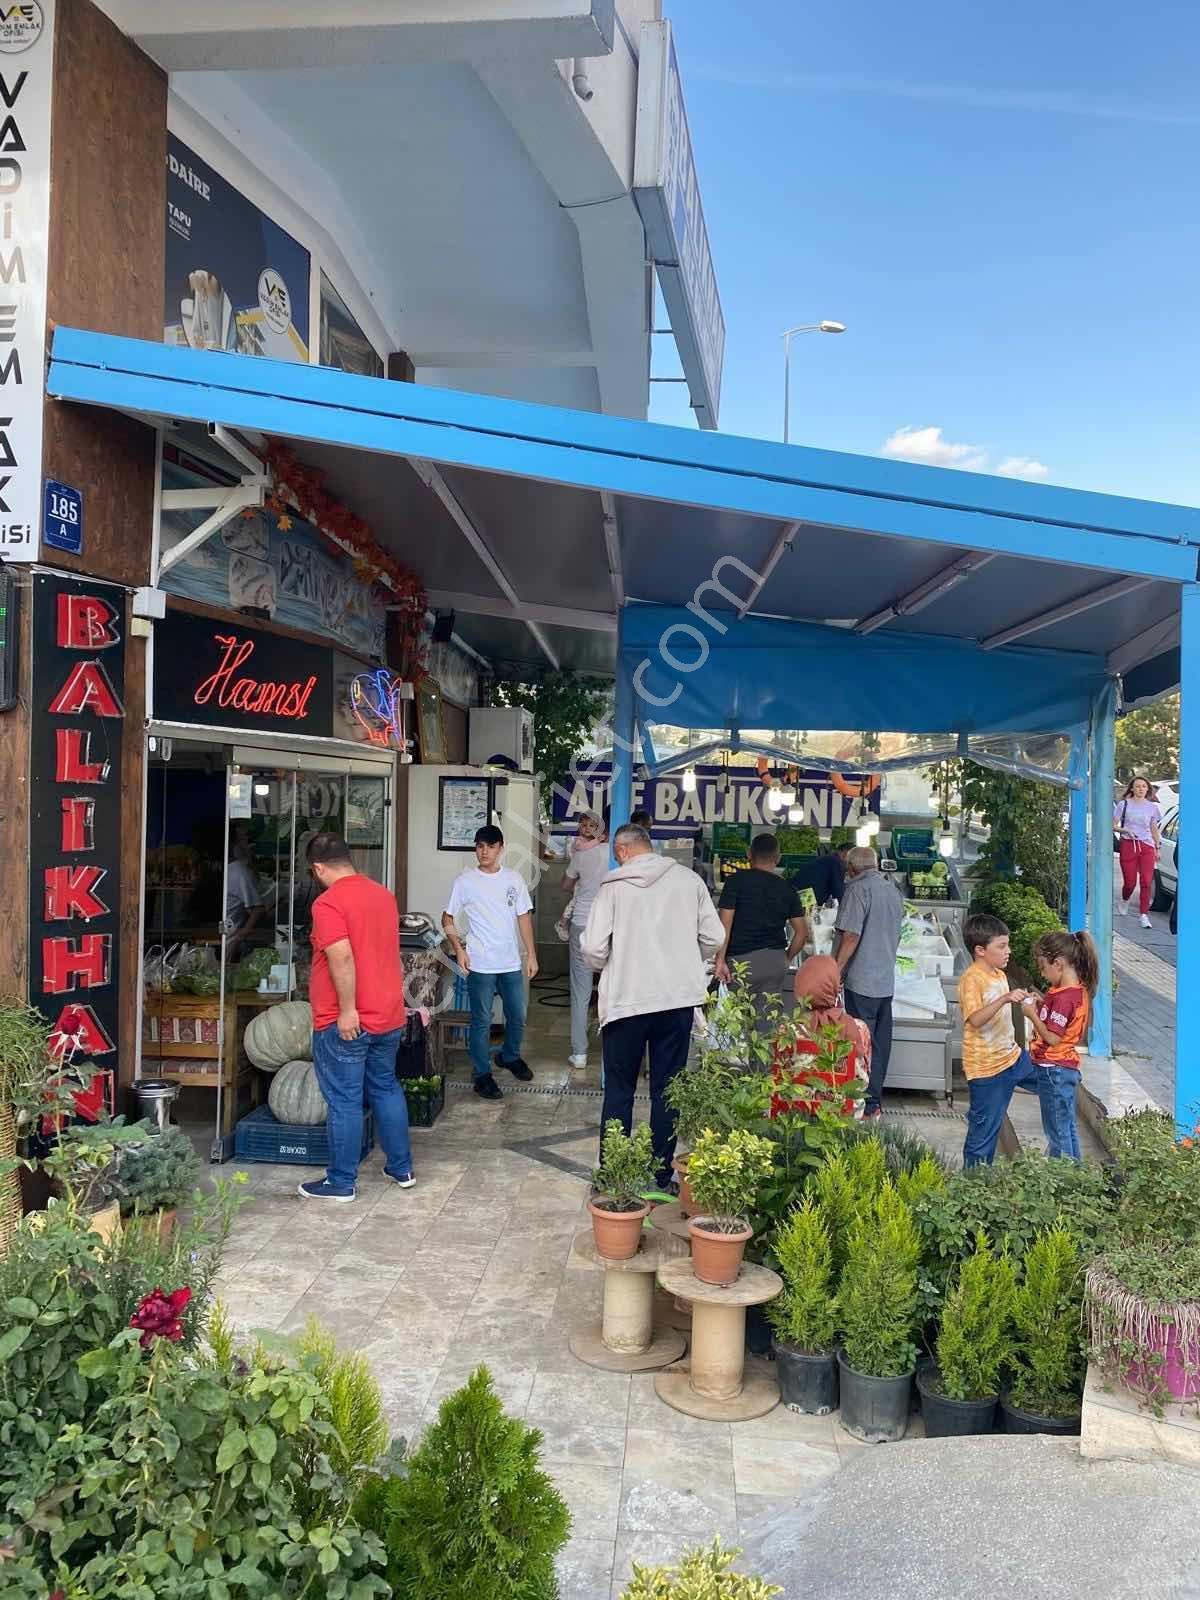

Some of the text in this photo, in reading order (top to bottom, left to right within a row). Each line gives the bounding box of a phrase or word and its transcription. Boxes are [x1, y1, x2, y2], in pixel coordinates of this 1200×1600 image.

[167, 200, 192, 228] TAPU
[51, 493, 79, 522] 185
[59, 523, 67, 537] A
[565, 779, 645, 818] AİE
